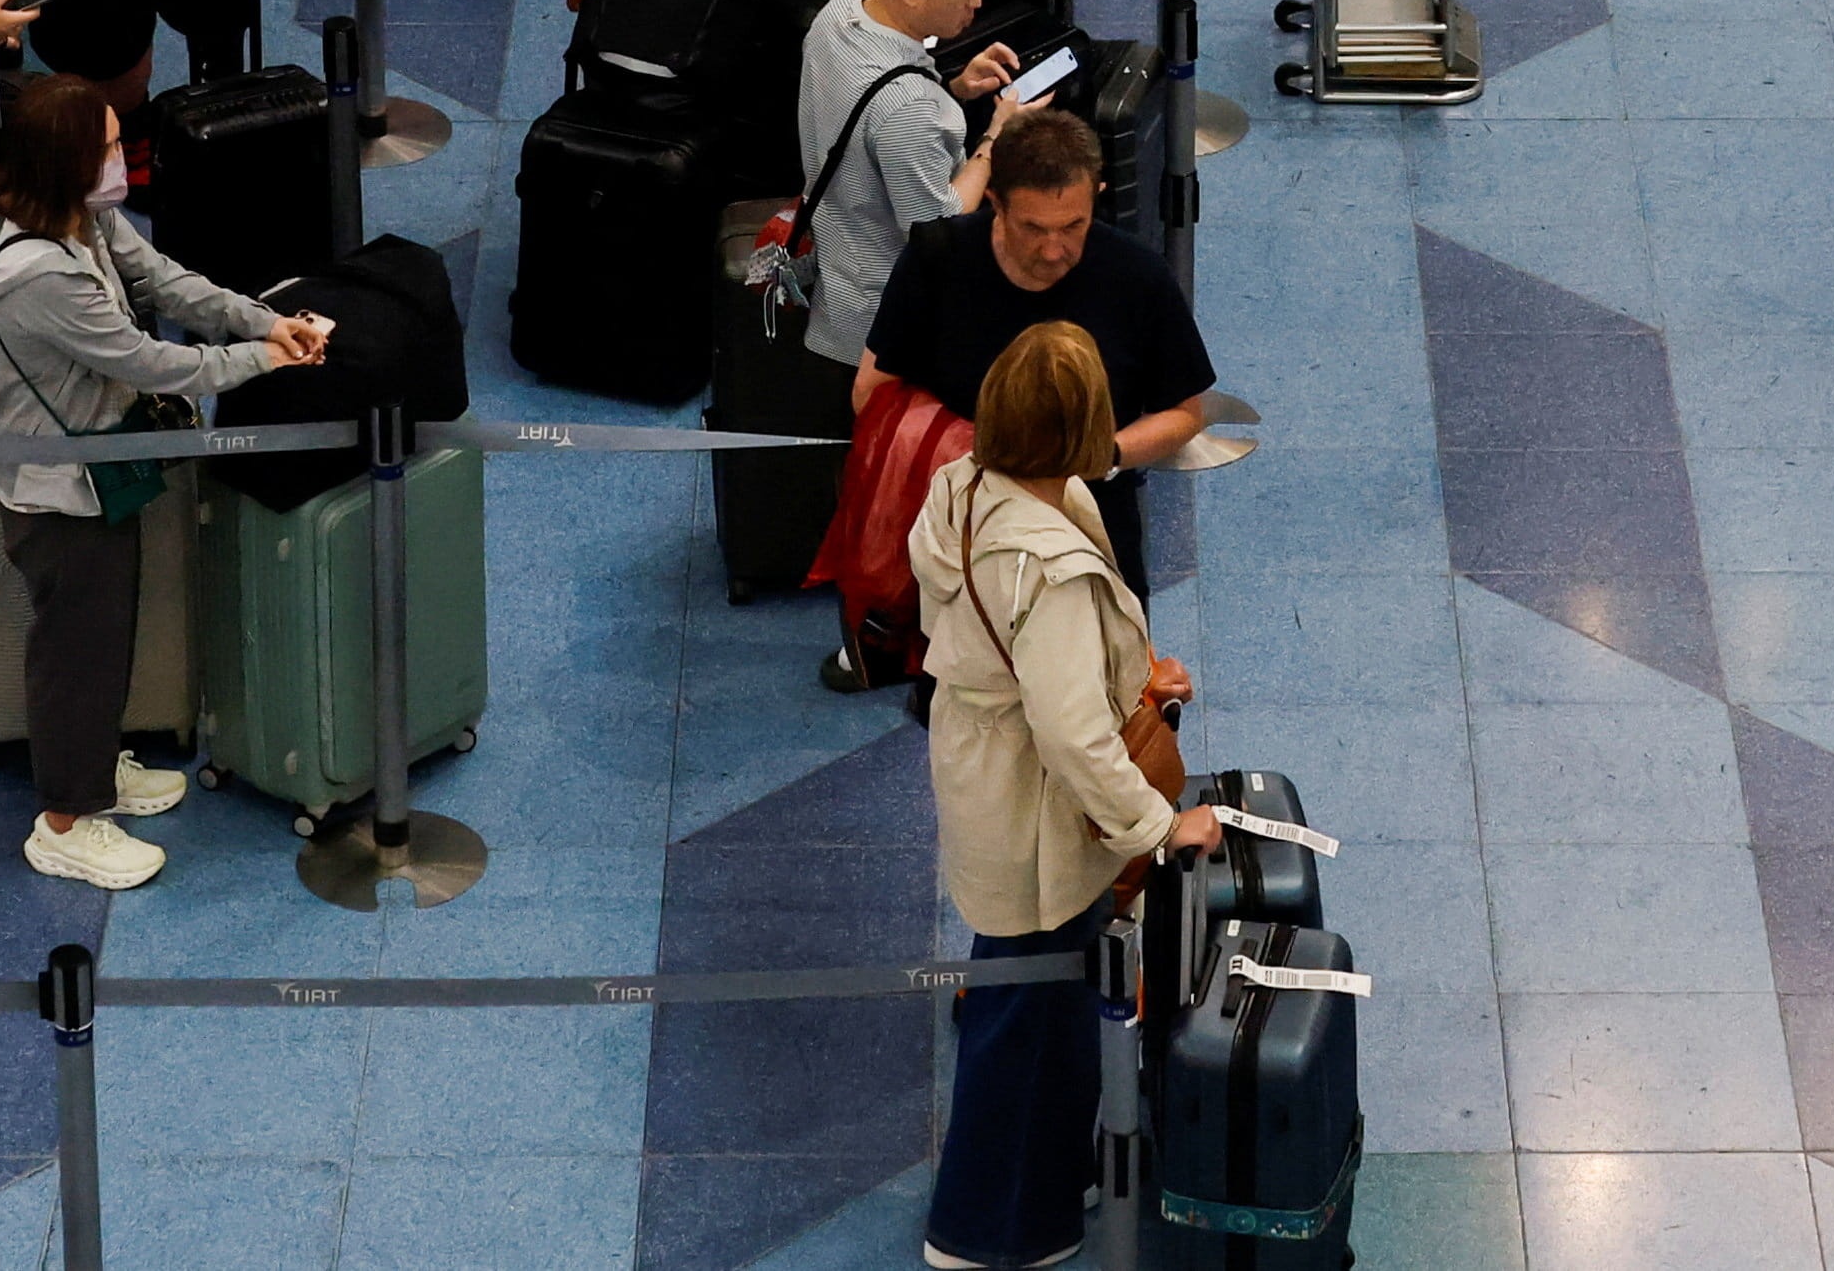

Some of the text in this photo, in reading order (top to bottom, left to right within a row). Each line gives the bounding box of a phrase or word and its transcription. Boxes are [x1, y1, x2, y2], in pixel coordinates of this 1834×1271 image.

[516, 426, 561, 441] TIAT
[213, 436, 258, 449] TIAT
[921, 973, 968, 987] TIAT
[292, 989, 340, 1003] TIAT
[608, 987, 655, 1000] TIAT
